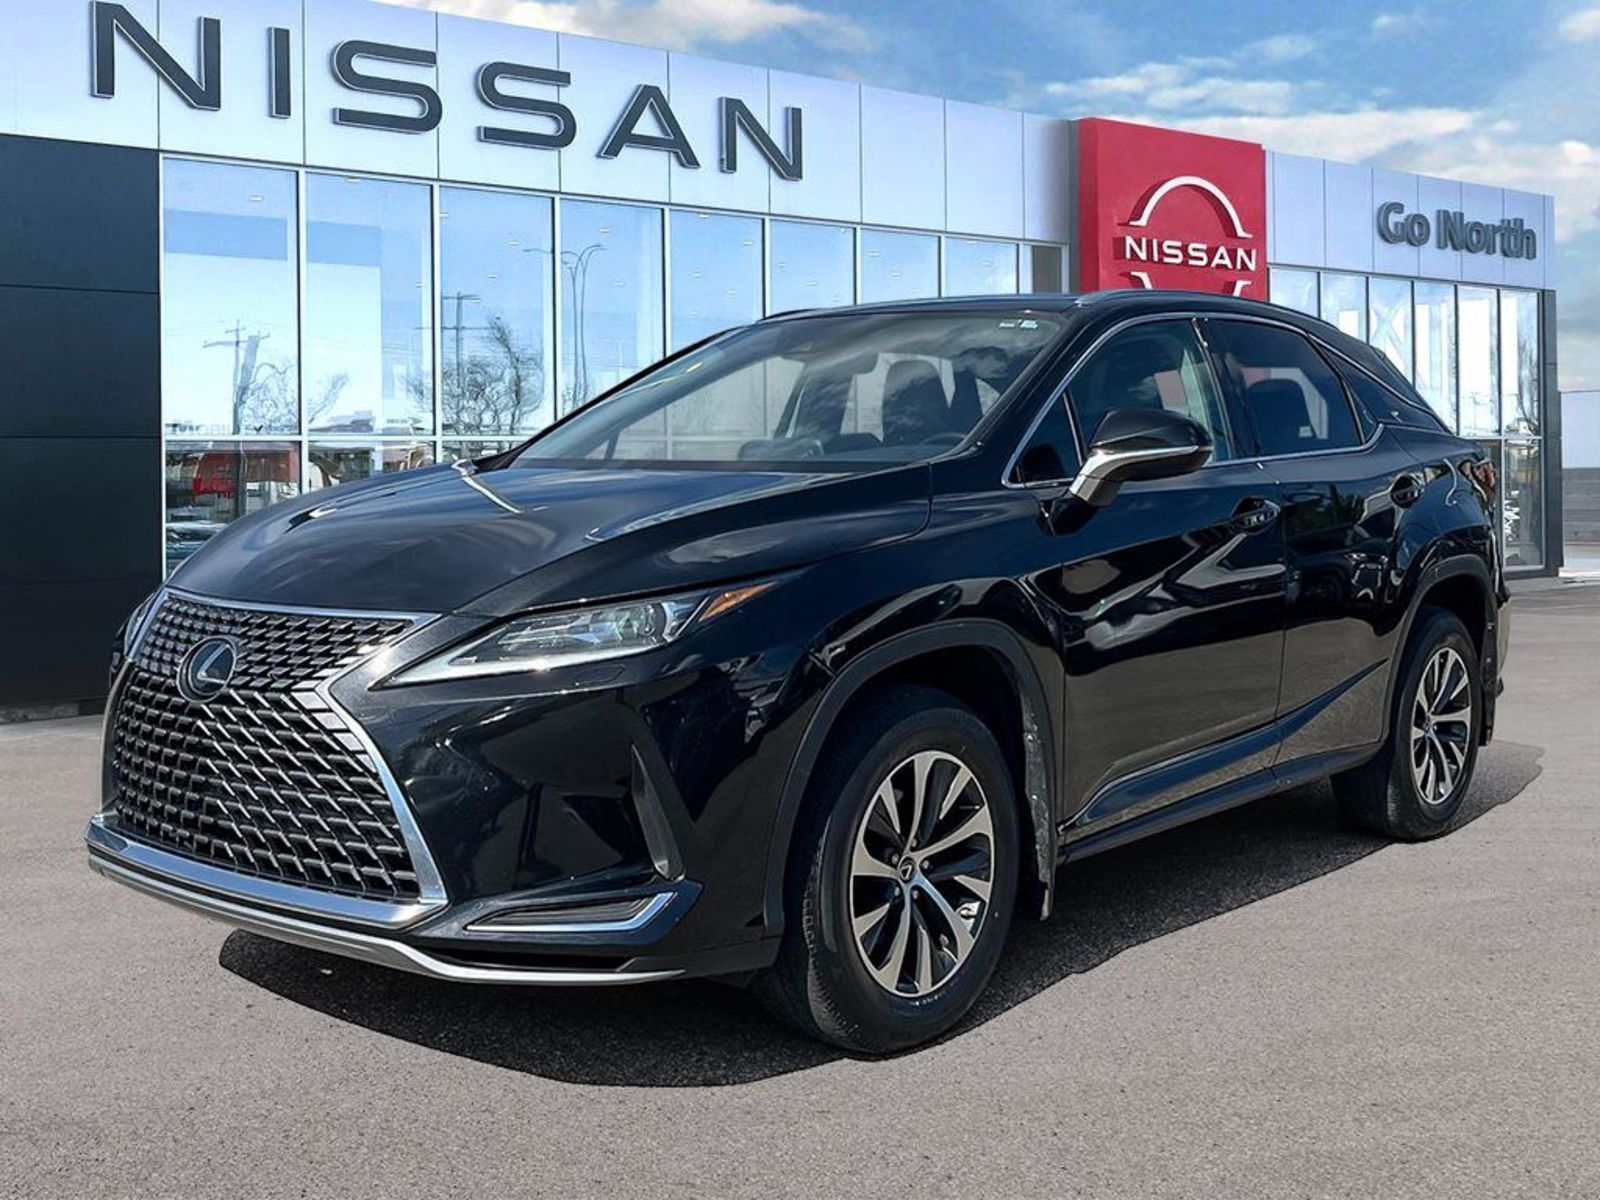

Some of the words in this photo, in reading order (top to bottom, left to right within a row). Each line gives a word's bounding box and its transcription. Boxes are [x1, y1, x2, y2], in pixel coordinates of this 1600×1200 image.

[91, 1, 803, 181] NISSAN
[1124, 235, 1257, 272] NISSAN
[1377, 201, 1431, 247] Go
[1435, 208, 1537, 260] North
